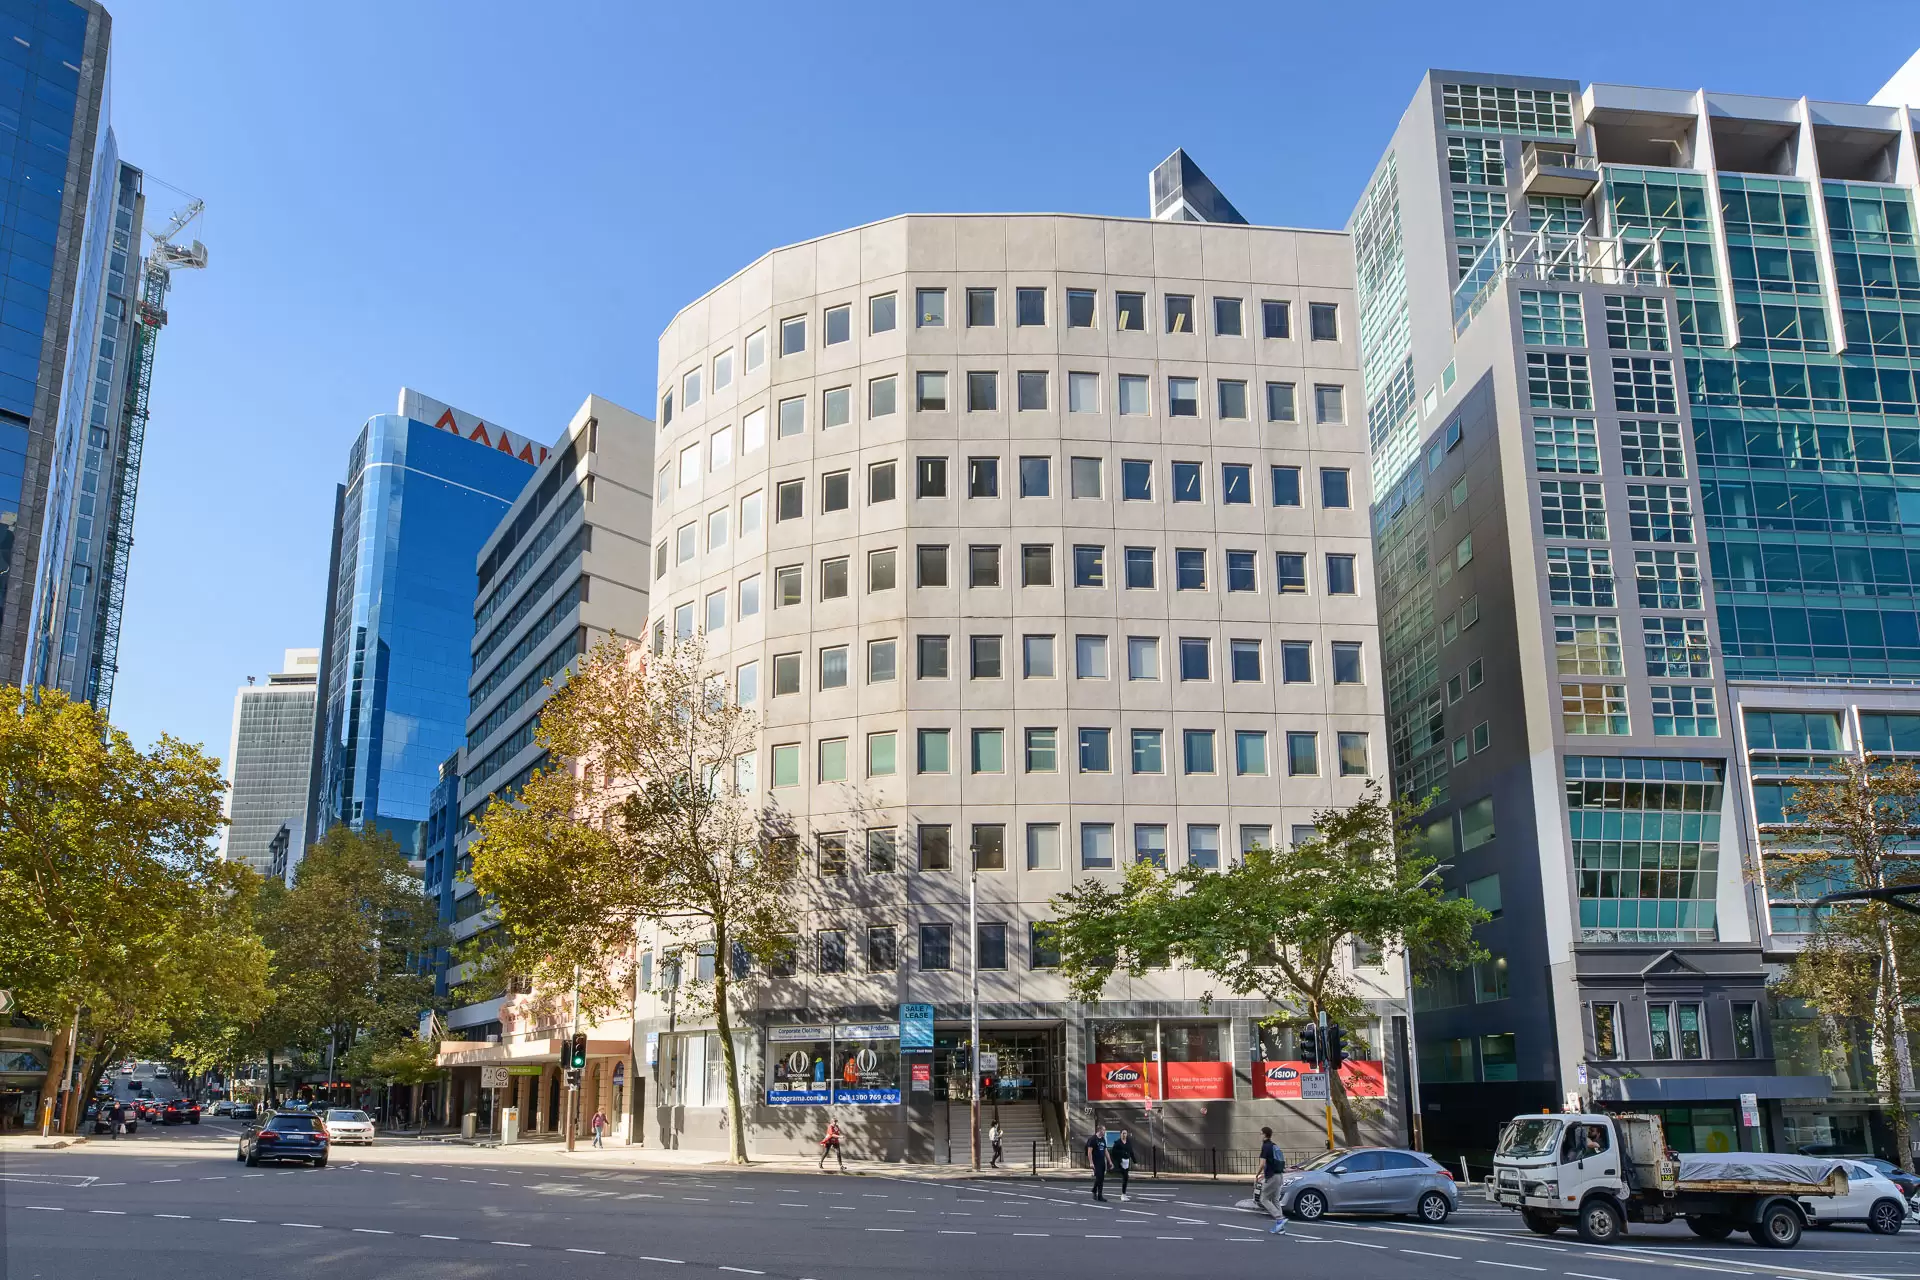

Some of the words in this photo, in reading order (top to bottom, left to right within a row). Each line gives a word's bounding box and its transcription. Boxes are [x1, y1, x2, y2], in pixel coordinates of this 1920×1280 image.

[1108, 1066, 1138, 1081] VISION
[1267, 1064, 1297, 1078] VISION
[1084, 1107, 1093, 1115] 97
